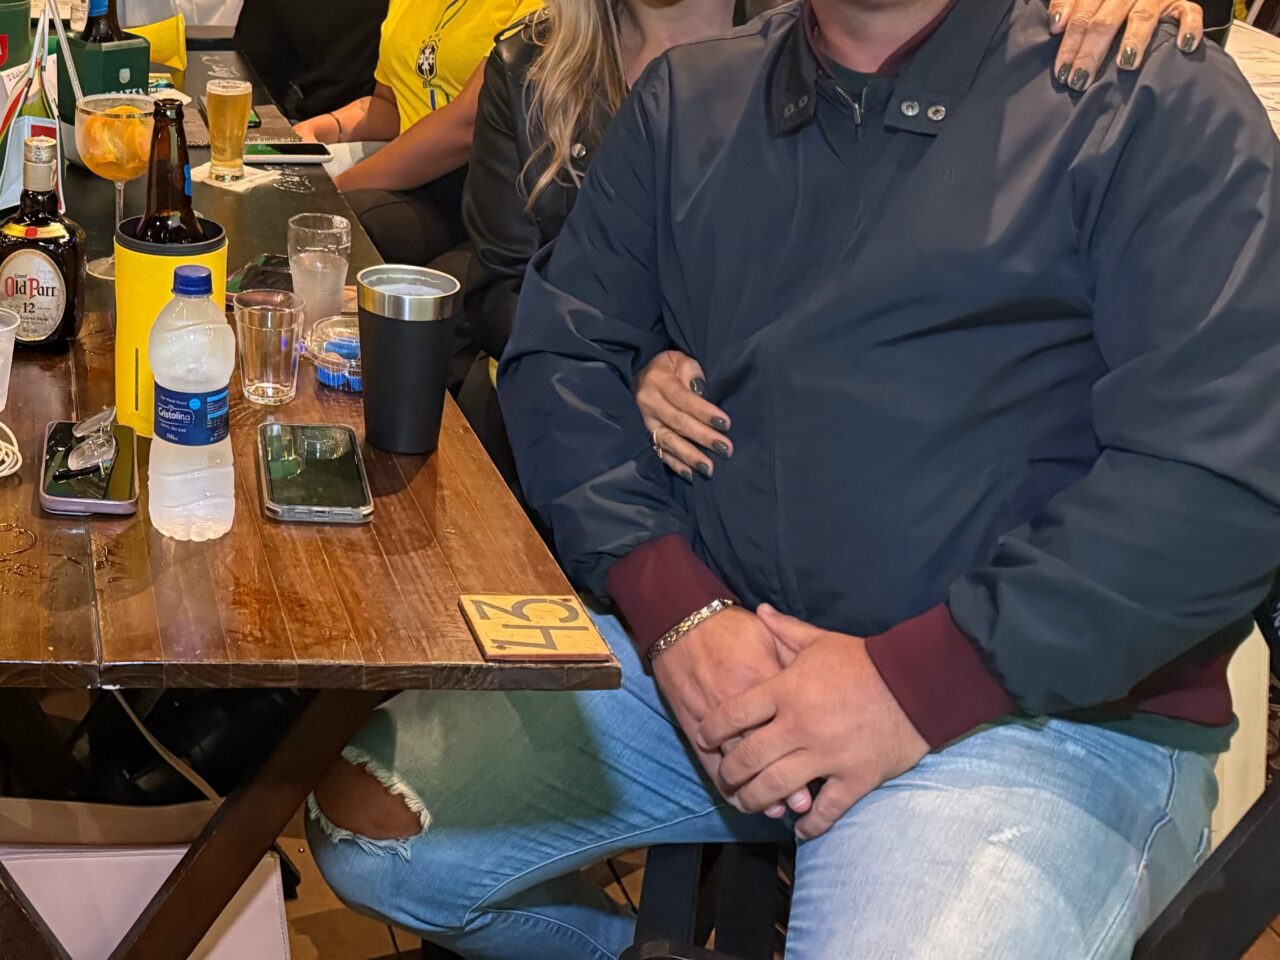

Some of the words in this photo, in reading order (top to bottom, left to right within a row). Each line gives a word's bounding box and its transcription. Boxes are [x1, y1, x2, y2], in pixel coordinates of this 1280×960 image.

[4, 276, 28, 299] Old
[27, 277, 58, 300] Parr
[22, 302, 36, 315] 12
[470, 597, 590, 651] 43
